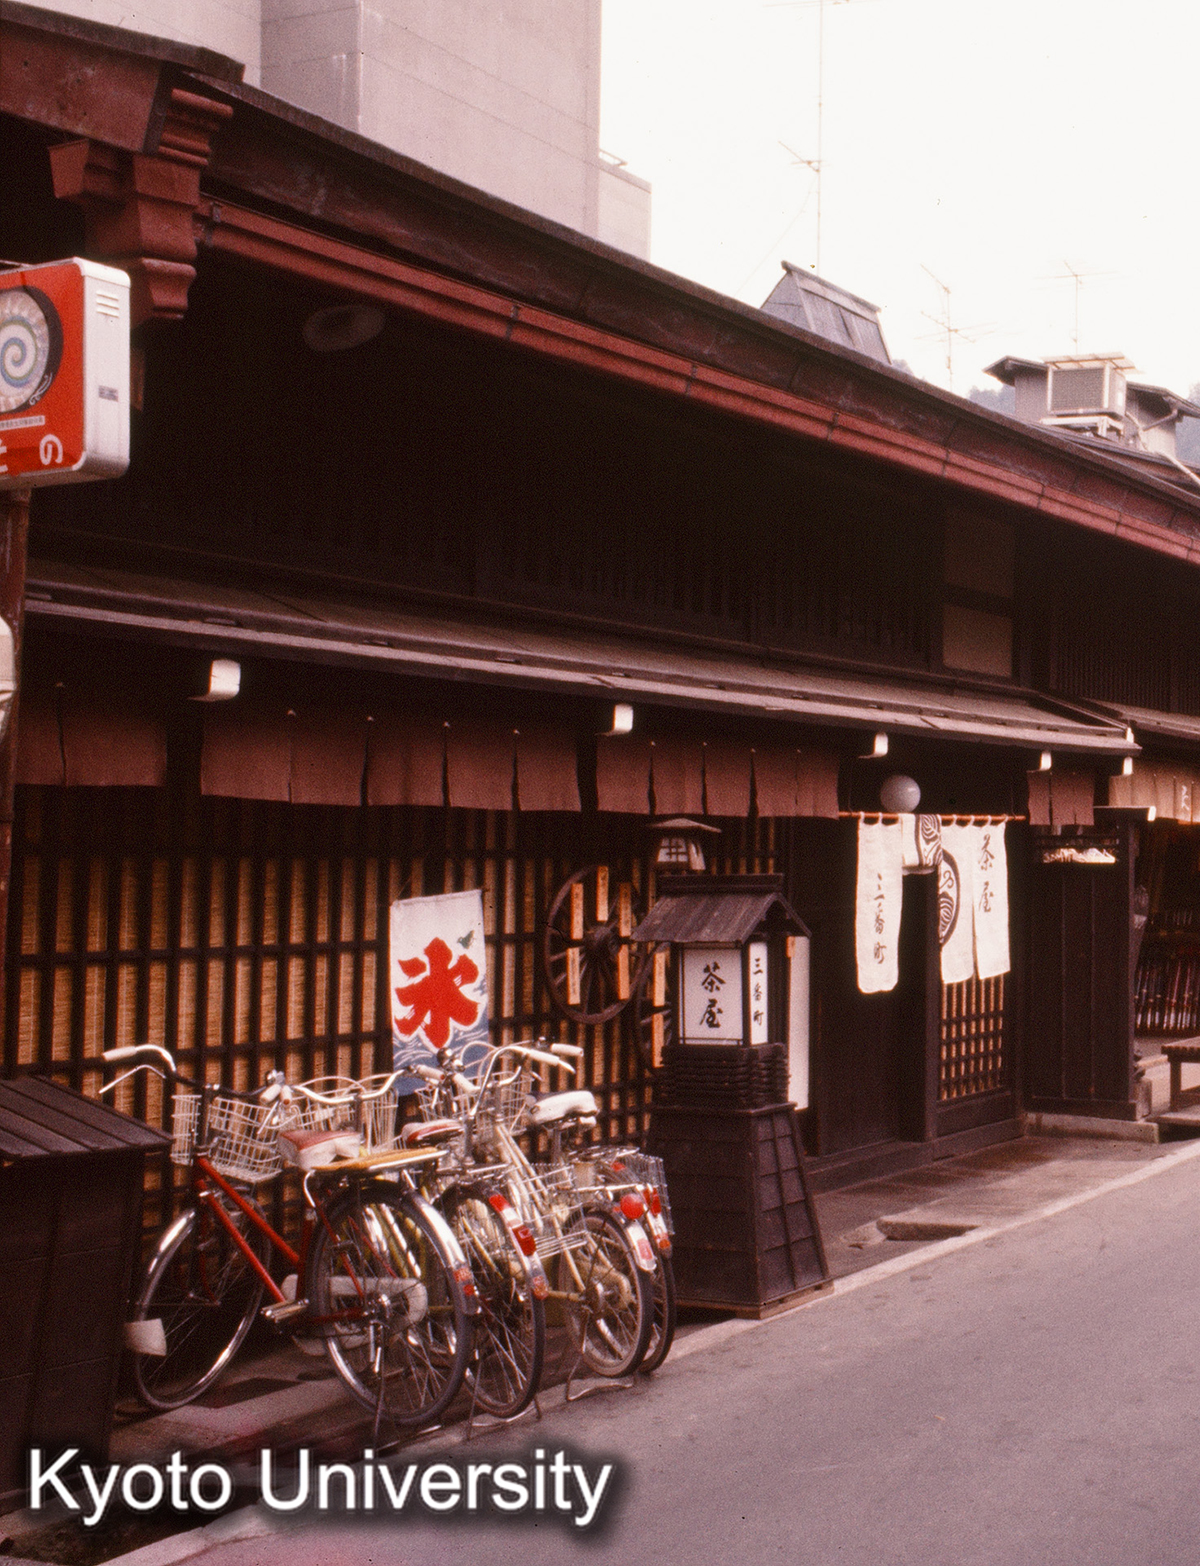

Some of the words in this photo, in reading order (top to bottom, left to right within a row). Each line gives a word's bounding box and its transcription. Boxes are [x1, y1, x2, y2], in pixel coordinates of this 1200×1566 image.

[978, 833, 995, 913] 茶屋
[394, 936, 479, 1049] 氷
[700, 961, 726, 1029] 茶屋
[753, 957, 764, 1026] 三番町
